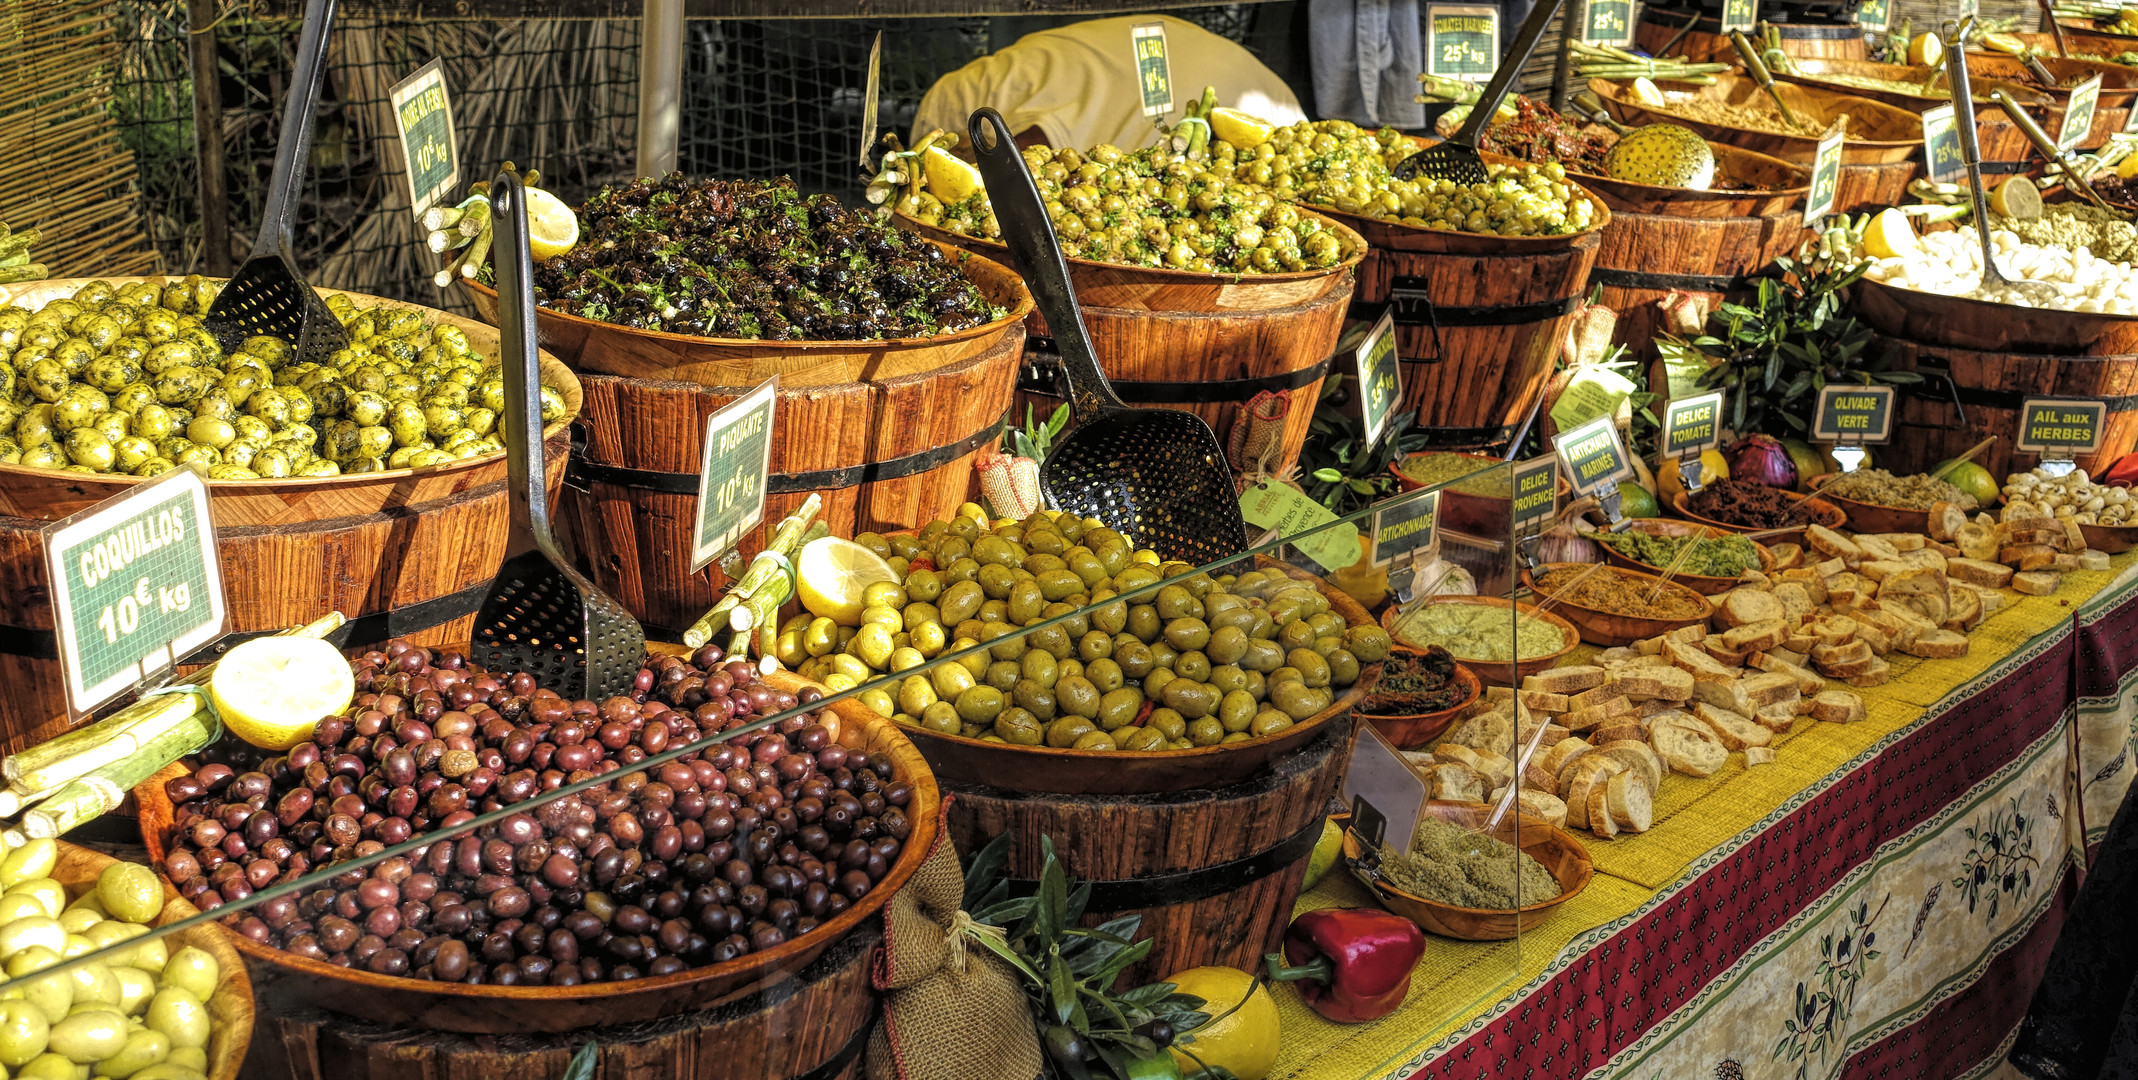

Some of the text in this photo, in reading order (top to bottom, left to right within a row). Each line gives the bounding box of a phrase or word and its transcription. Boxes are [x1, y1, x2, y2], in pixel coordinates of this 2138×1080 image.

[1434, 17, 1462, 35] TOMATES
[1593, 10, 1614, 29] 25€
[1443, 41, 1485, 65] 25€ kg
[1145, 66, 1158, 92] 10€
[400, 99, 420, 134] NOIRE
[416, 94, 428, 120] AIL
[417, 134, 447, 175] 10€ kg
[1676, 406, 1711, 426] DELICE
[1835, 397, 1877, 410] OLIVADE
[1837, 415, 1869, 428] VERTE
[2034, 410, 2089, 424] AIL aux
[719, 410, 764, 459] PIQUANTE
[1672, 423, 1711, 444] TOMATE
[2031, 427, 2091, 440] HERBES
[1568, 431, 1611, 463] ARTICHAUD
[1580, 451, 1615, 480] MARINÉS
[716, 464, 755, 514] 10€ kg
[1520, 471, 1548, 492] DELICE
[1293, 497, 1304, 509] de
[1514, 487, 1554, 513] PROVENCE
[1377, 512, 1433, 544] ARTICHONNADE
[80, 505, 185, 588] COQUILLOS
[98, 576, 191, 645] 10€ kg
